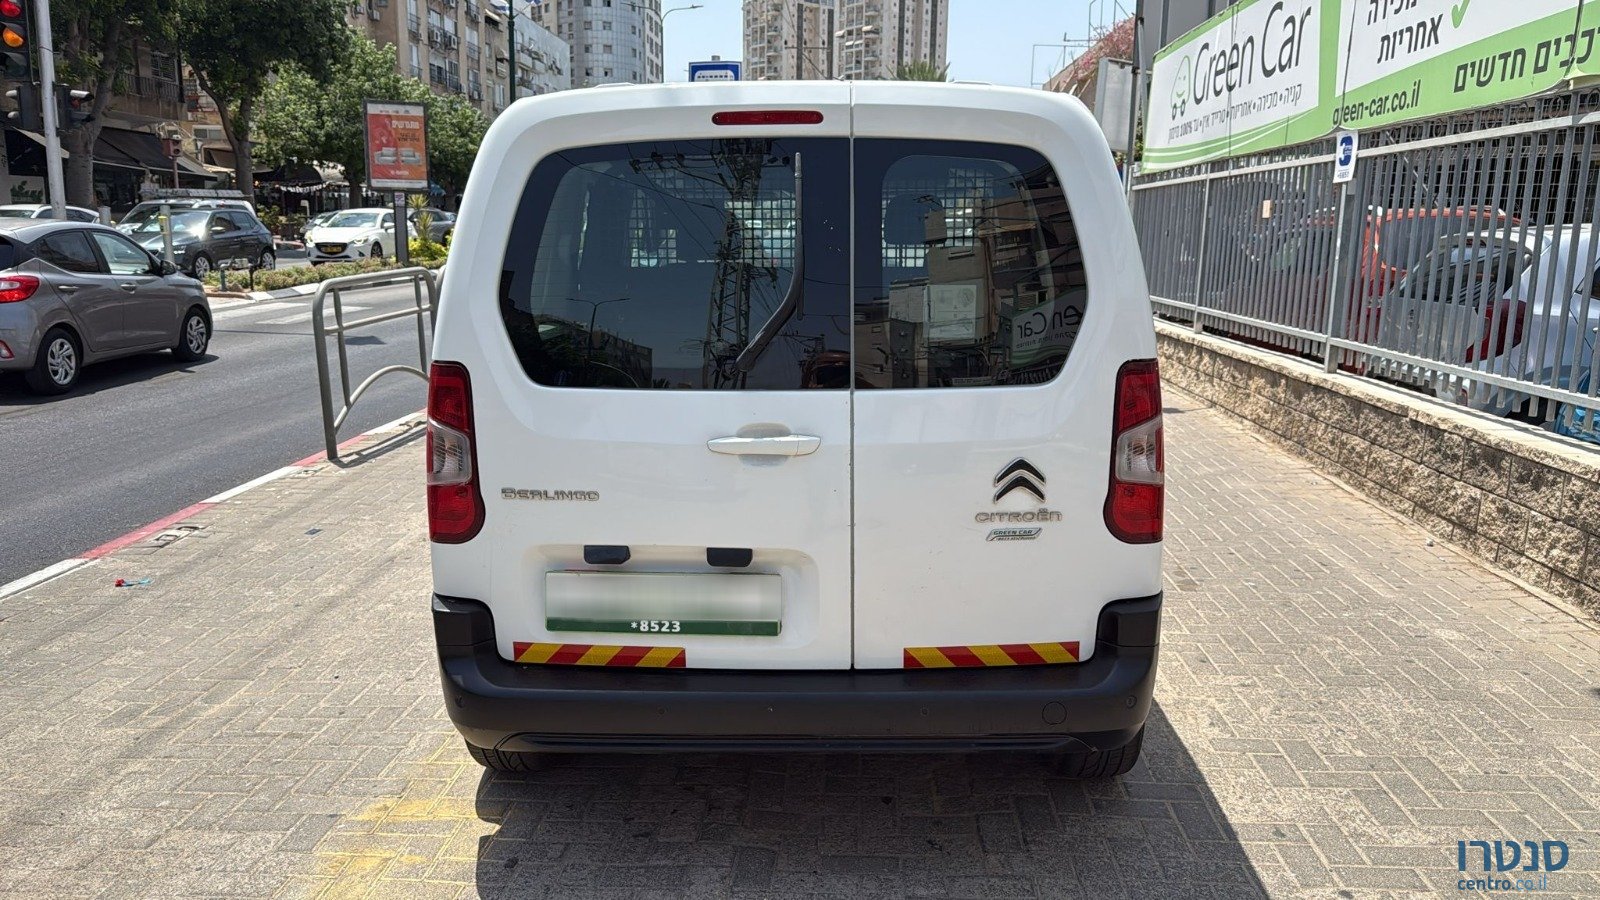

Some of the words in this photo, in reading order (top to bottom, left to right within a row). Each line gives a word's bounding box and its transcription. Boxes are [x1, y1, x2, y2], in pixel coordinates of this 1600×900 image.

[1193, 35, 1255, 105] Green
[1261, 1, 1312, 78] Car
[1377, 13, 1444, 64] אחריות
[1533, 26, 1600, 75] כבים
[1453, 48, 1527, 93] חדשים
[1257, 91, 1278, 112] מכירה
[1283, 83, 1302, 107] קניה
[501, 487, 600, 501] BERLINGO
